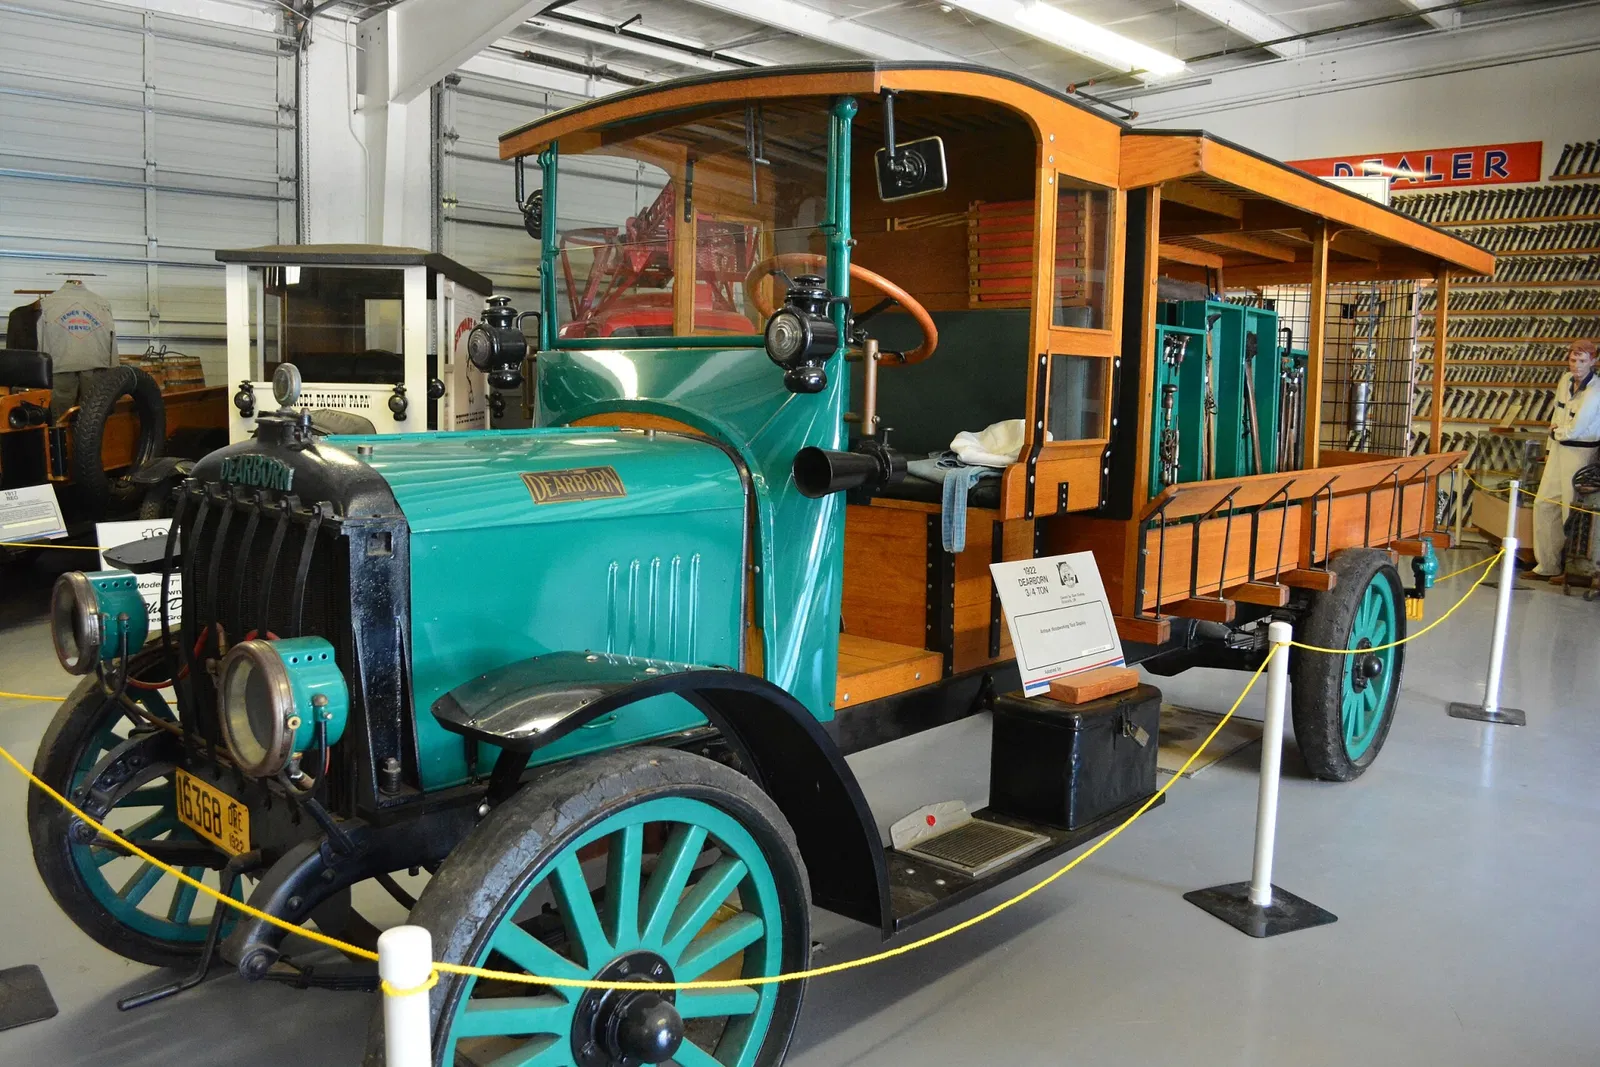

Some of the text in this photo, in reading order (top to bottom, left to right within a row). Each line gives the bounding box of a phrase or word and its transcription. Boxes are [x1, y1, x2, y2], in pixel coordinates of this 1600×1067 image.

[1333, 151, 1510, 184] DEALER
[220, 454, 295, 492] DEARBORN
[525, 467, 624, 501] DEARBORN
[1017, 575, 1049, 587] DEARBORN
[1023, 566, 1037, 575] 1922
[1037, 586, 1049, 595] TON
[177, 774, 223, 840] 16368
